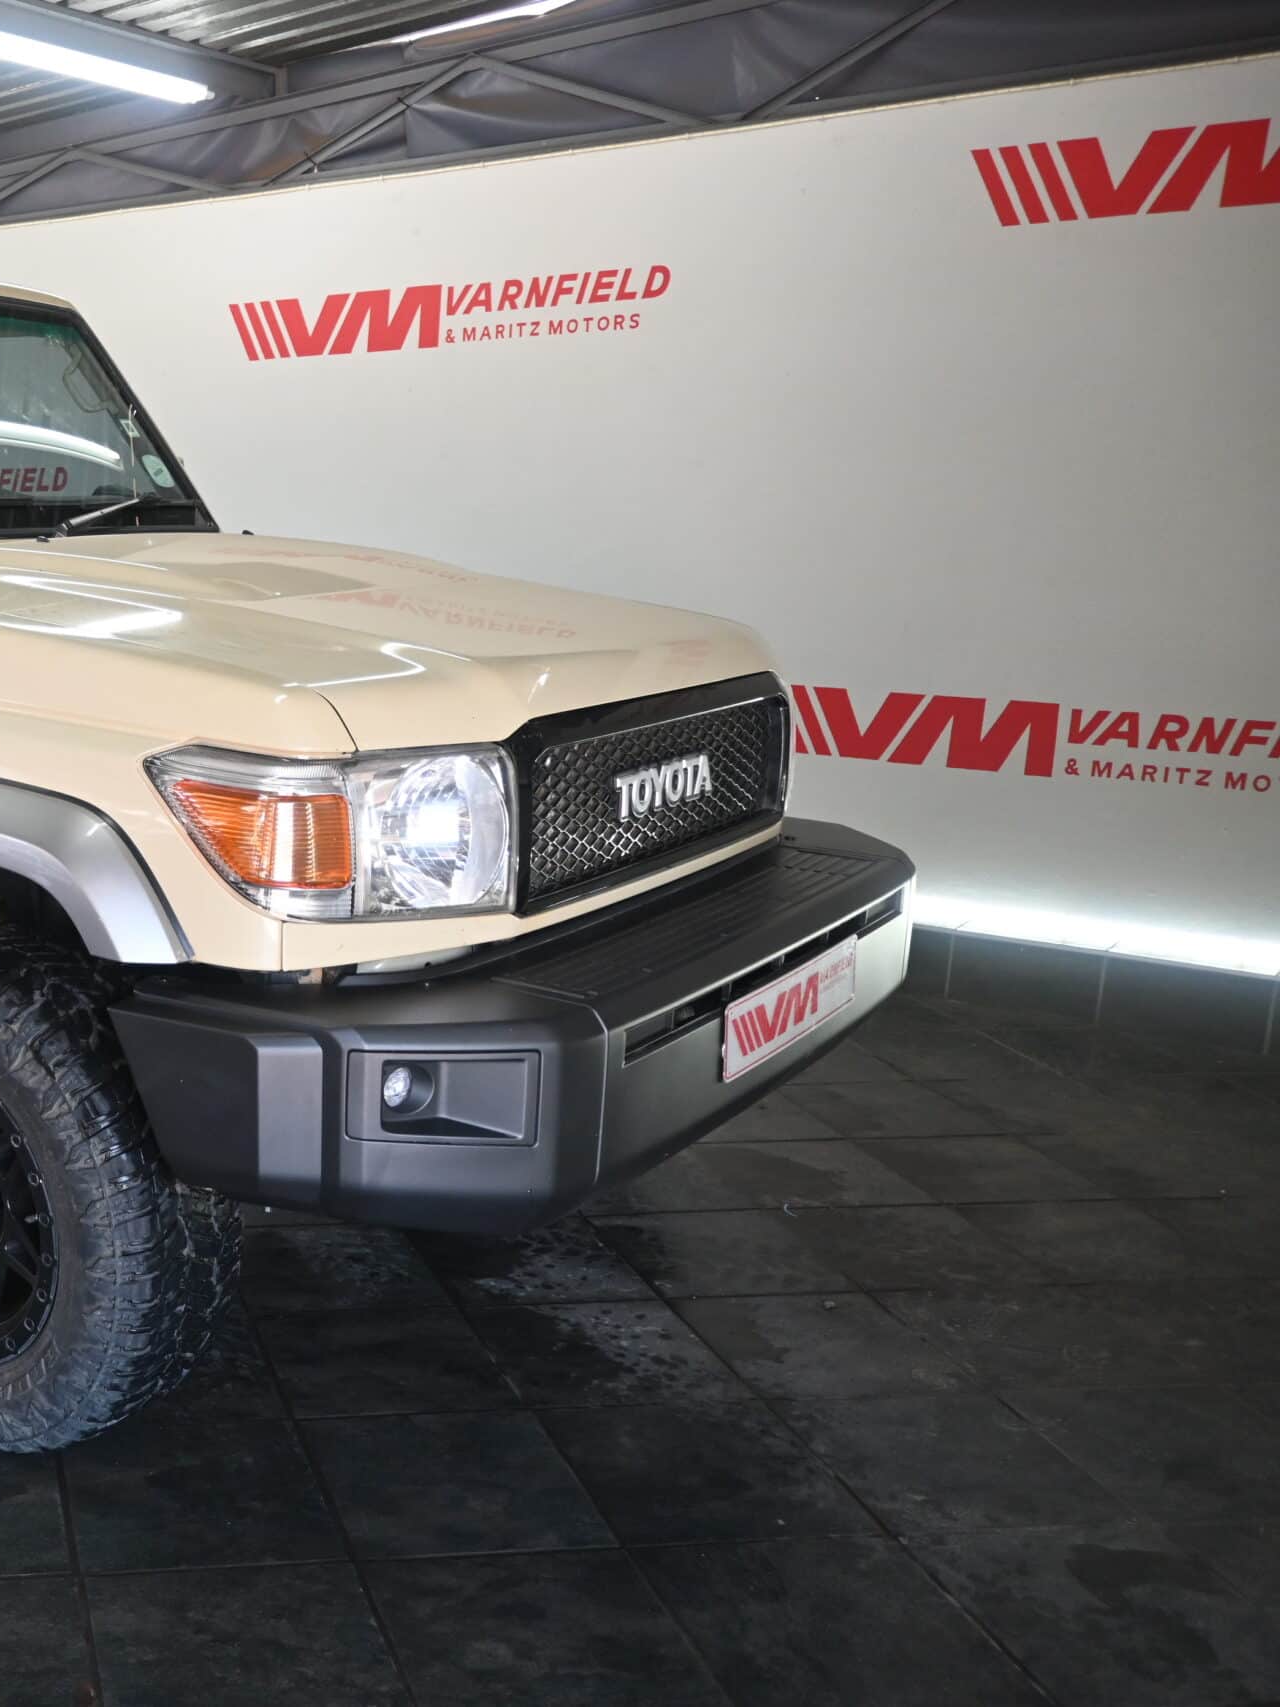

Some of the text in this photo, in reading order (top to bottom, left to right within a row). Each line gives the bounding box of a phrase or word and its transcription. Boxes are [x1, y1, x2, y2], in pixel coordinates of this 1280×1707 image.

[1057, 118, 1280, 219] VM
[276, 284, 442, 357] VM
[446, 265, 672, 317] VARNFIELD
[445, 313, 641, 344] & MARITZ MOTORS
[813, 686, 1060, 778] VM
[616, 754, 712, 819] TOYOTA
[1065, 759, 1280, 793] & MARITZ MO
[754, 971, 820, 1044] VM
